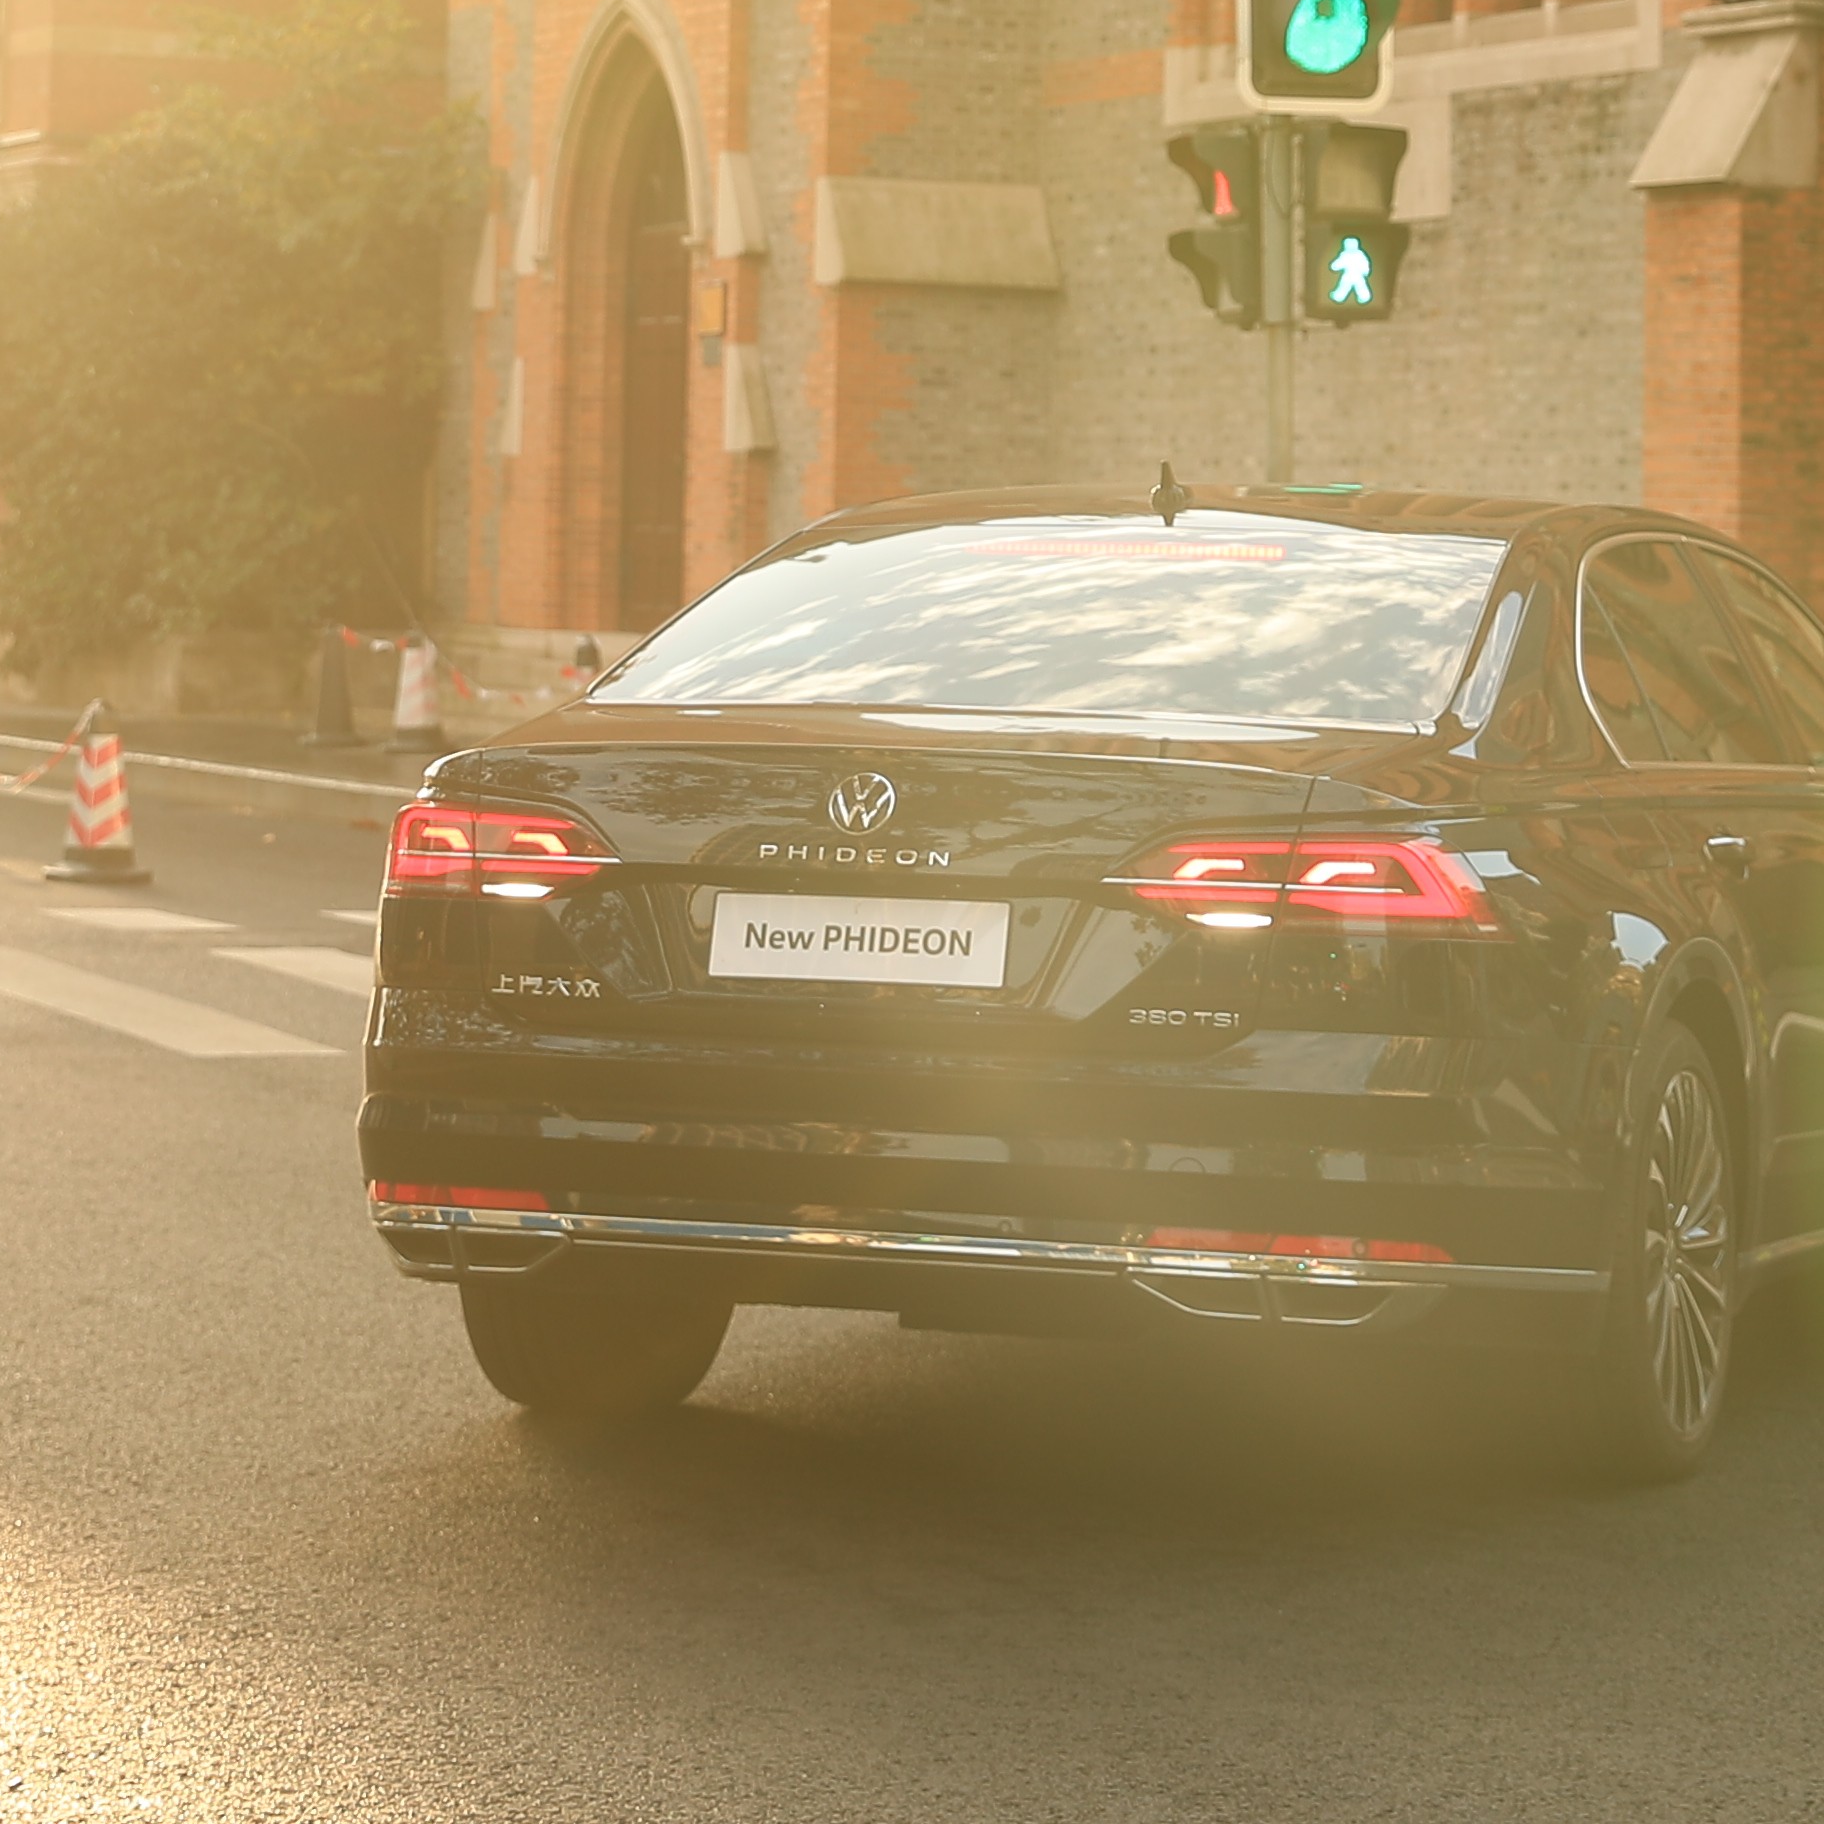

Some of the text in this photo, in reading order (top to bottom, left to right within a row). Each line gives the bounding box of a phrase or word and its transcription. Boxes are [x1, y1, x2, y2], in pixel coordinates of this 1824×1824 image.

[759, 843, 951, 867] PHIDEON
[744, 922, 973, 957] New PHIDEON
[491, 973, 601, 998] 上汽大众
